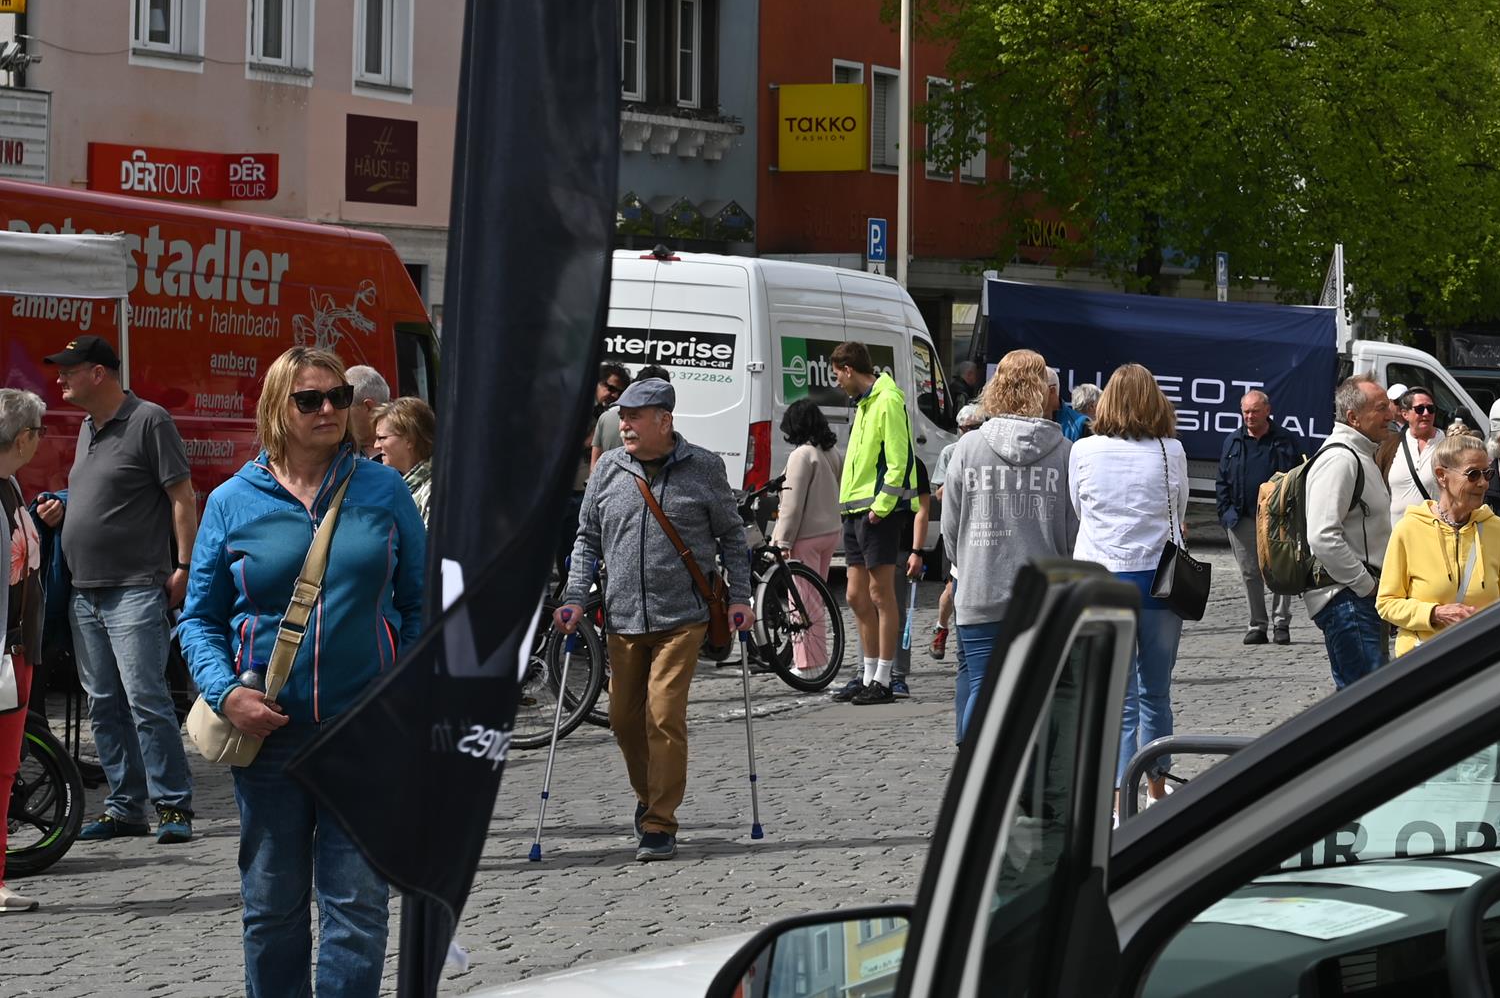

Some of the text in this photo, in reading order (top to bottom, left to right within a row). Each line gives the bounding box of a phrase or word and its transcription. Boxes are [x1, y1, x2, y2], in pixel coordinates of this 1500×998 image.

[121, 157, 201, 195] DERTOUR
[229, 160, 266, 182] DER
[354, 153, 411, 180] HÄUSLER
[229, 183, 266, 198] TOUR
[870, 224, 880, 255] P
[209, 306, 280, 338] hahnbach
[209, 351, 257, 378] amberg
[670, 357, 732, 368] rent-a-car
[679, 371, 733, 383] 3722826
[195, 391, 244, 411] neumarkt
[964, 465, 1060, 492] BETTER
[968, 493, 1057, 521] FUTURE
